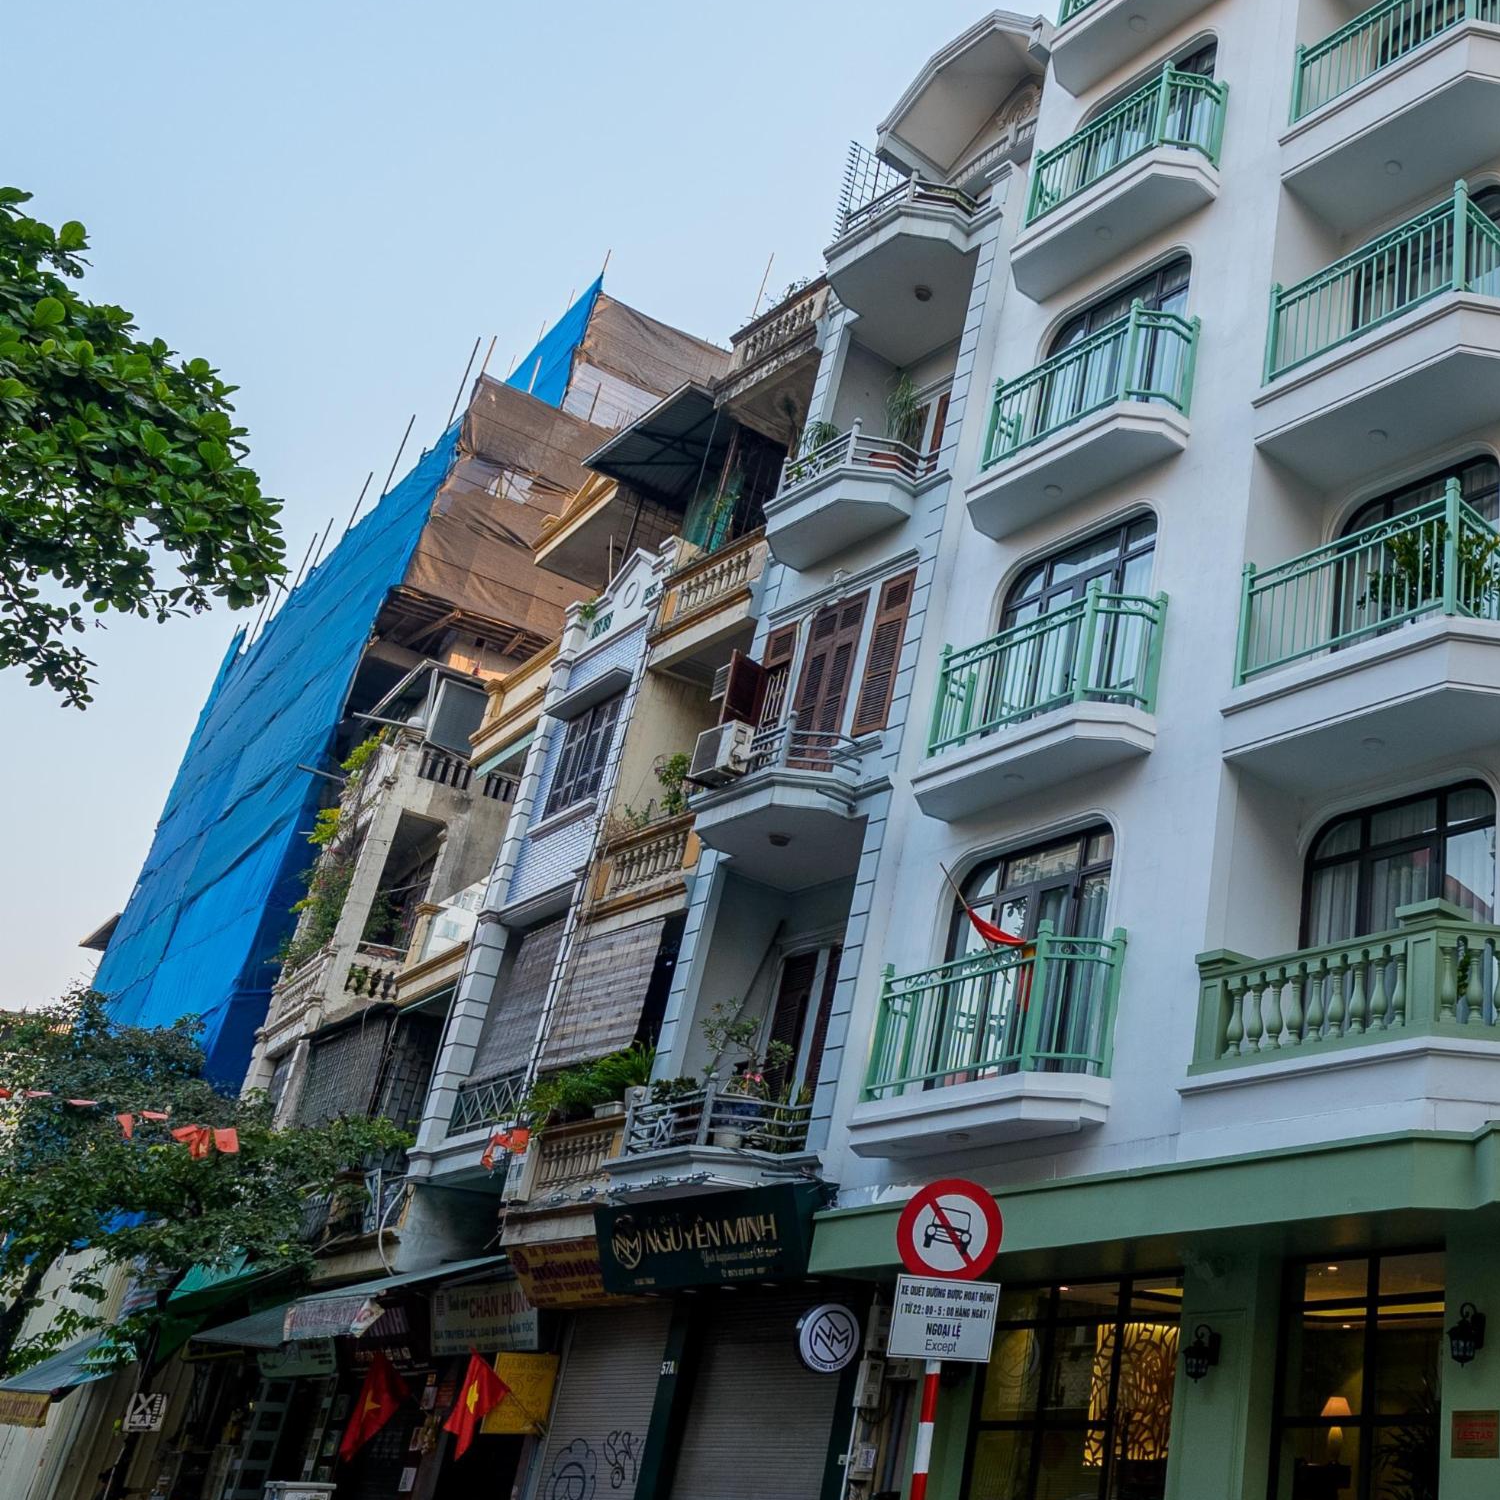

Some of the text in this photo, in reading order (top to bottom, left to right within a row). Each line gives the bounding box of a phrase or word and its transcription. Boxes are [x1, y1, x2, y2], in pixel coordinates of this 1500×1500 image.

[723, 1213, 778, 1246] MINH
[901, 1284, 994, 1305] XE QUÉT ĐƯỜNG ĐƯỢC HOẠT ĐỘNG
[955, 1305, 970, 1318] HÀNG
[926, 1323, 962, 1340] NGOẠI LỆ
[925, 1339, 957, 1354] Except
